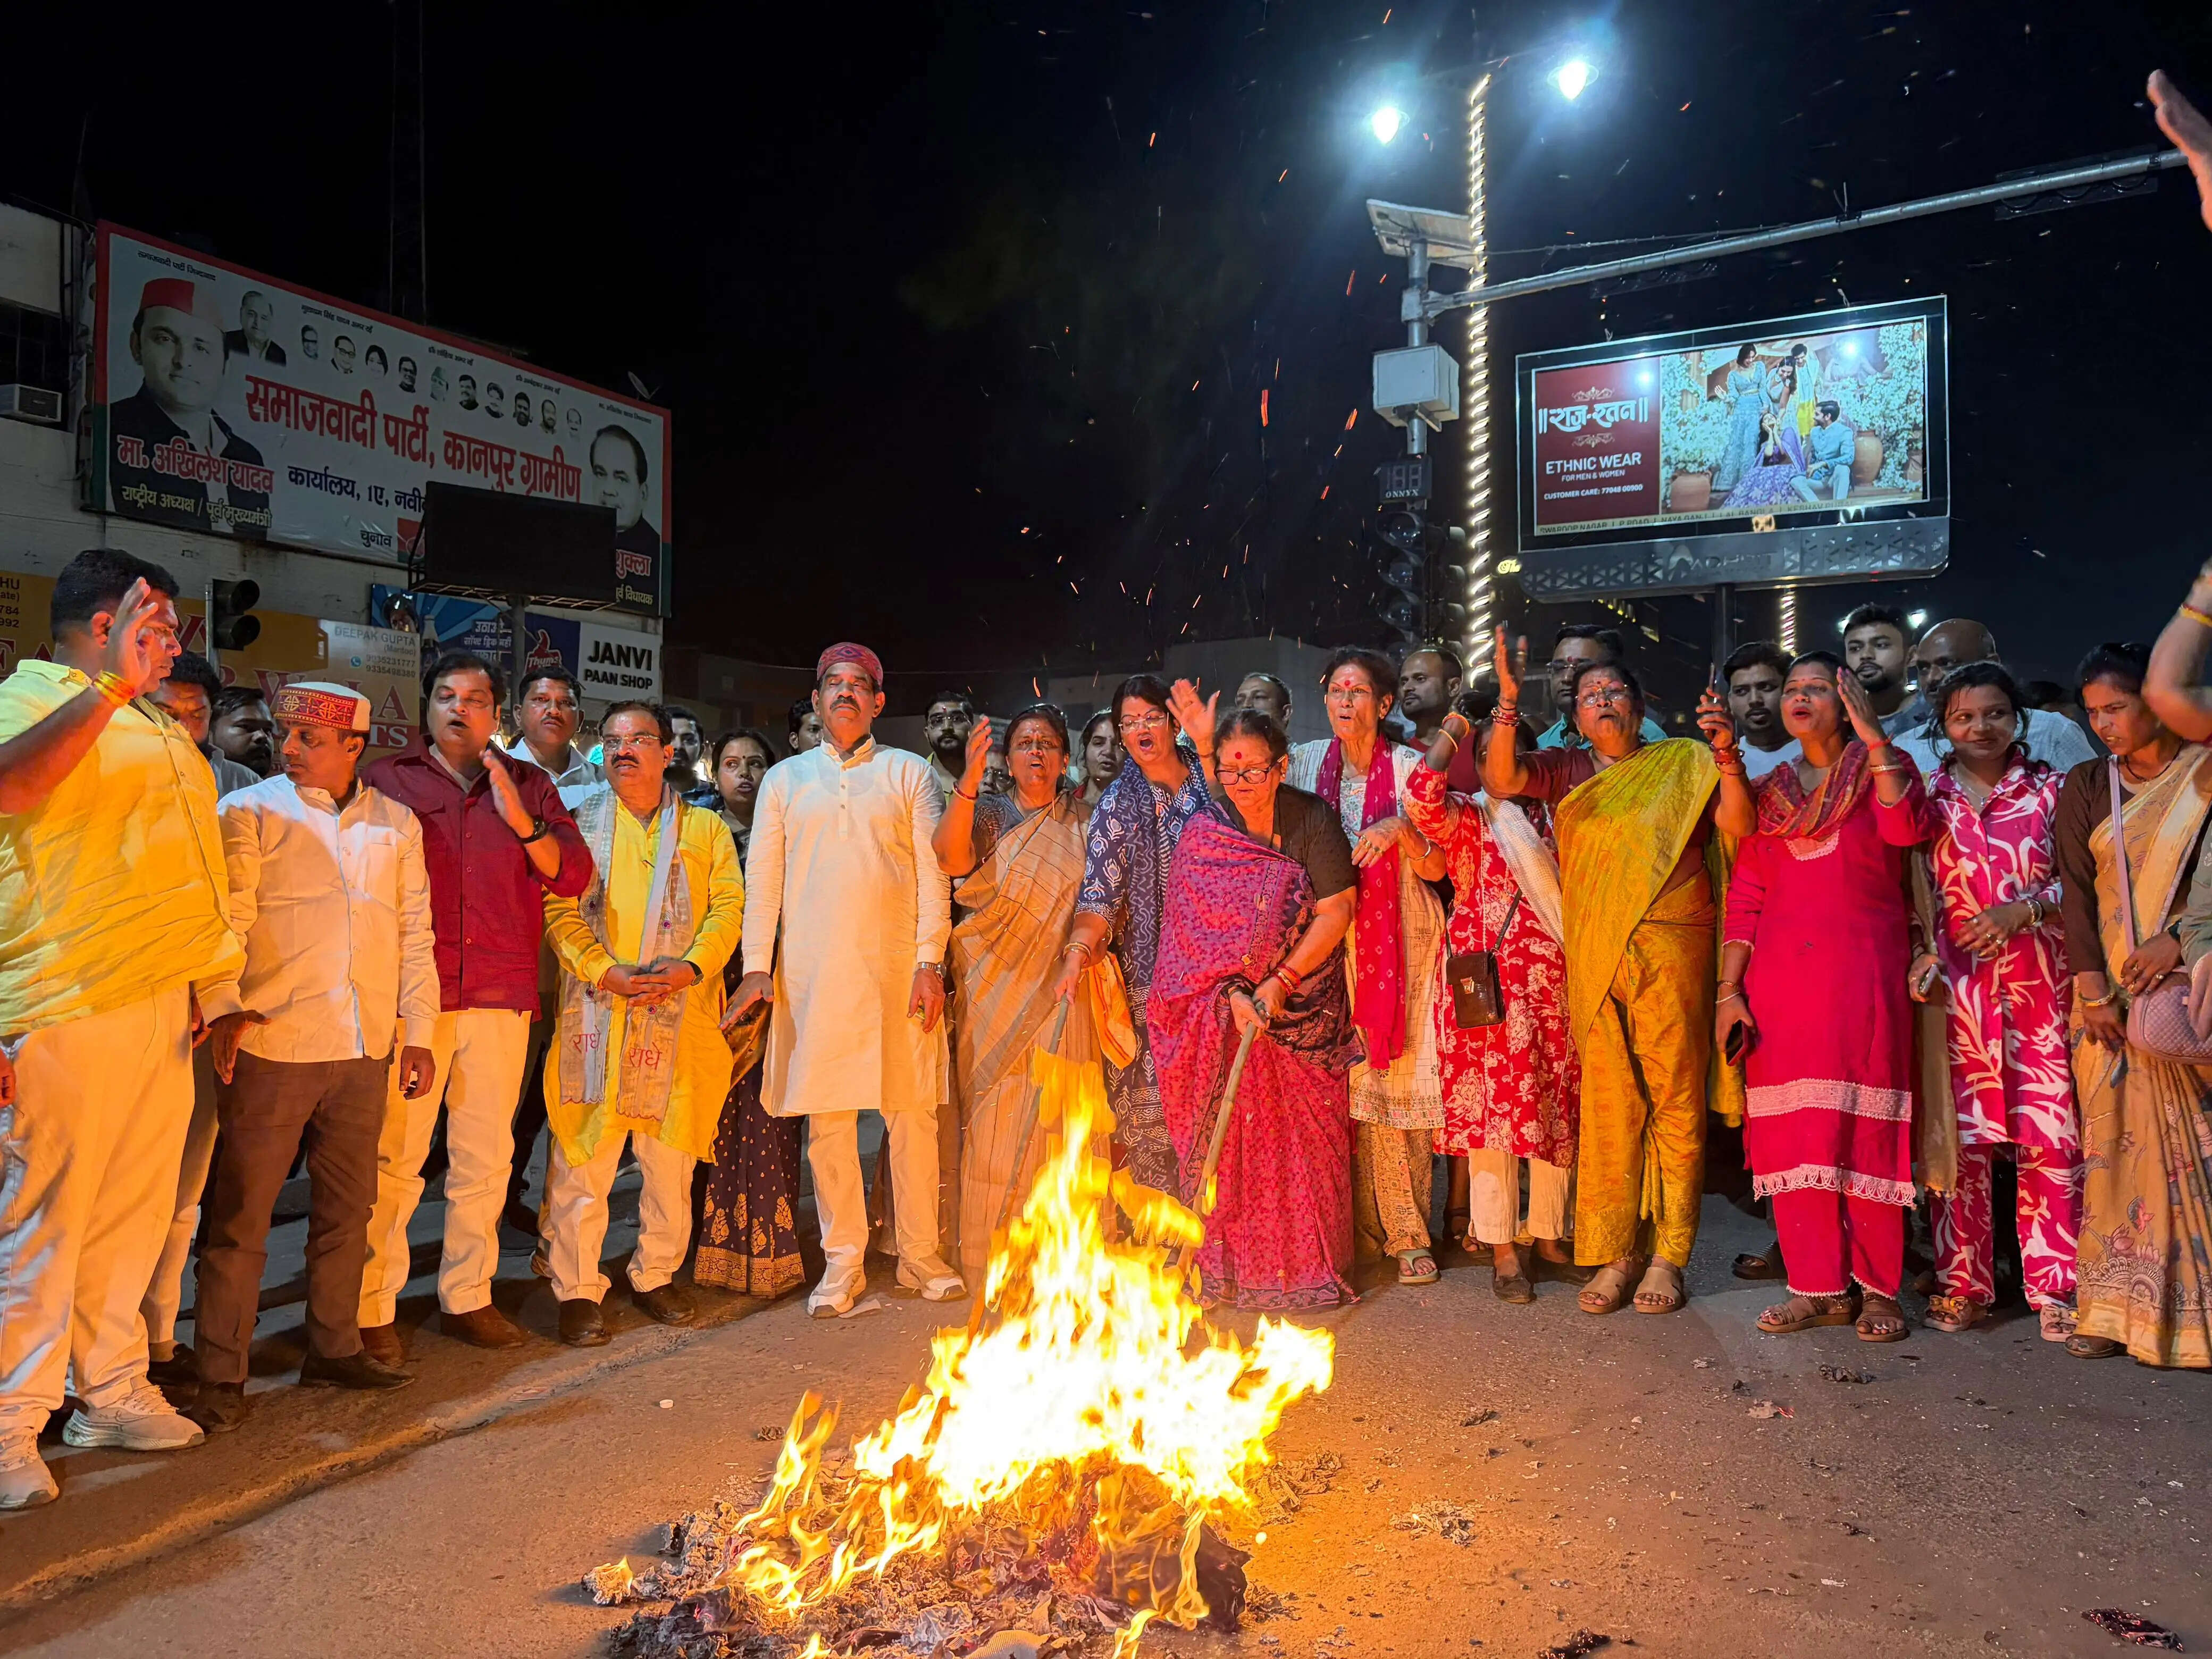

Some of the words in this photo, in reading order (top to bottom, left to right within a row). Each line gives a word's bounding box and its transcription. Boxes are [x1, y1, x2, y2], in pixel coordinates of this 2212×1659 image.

[138, 250, 171, 267] समाजवादी
[246, 374, 378, 449] समाजवादी
[383, 405, 434, 469] पार्टी,
[520, 445, 582, 504] ग्रामीण
[152, 436, 229, 485] अखिलेश
[230, 459, 274, 493] यादव
[1546, 456, 1596, 474] ETHNIC
[1598, 451, 1642, 469] WEAR
[288, 466, 361, 501] कार्यालय,
[1561, 473, 1575, 482] FOR
[1575, 472, 1592, 481] MEN
[1598, 469, 1626, 480] WOMEN
[1385, 489, 1419, 498] ONNYX
[1544, 490, 1580, 500] CUSTOMER
[1580, 488, 1600, 497] CARE:
[122, 483, 158, 508] राष्ट्रीय
[159, 493, 196, 512] अध्यक्ष
[206, 498, 224, 523] पूर्व
[223, 505, 273, 528] मुख्यमंत्री
[361, 530, 392, 548] चुनाव
[625, 585, 654, 606] विधायक
[334, 626, 378, 641] DEEPAK
[383, 633, 415, 647] GUPTA
[528, 656, 560, 668] Thums
[588, 640, 652, 671] JANVI
[583, 668, 618, 685] PAAN
[620, 674, 653, 690] SHOP
[572, 1025, 601, 1053] राधे
[629, 1042, 663, 1070] राधे
